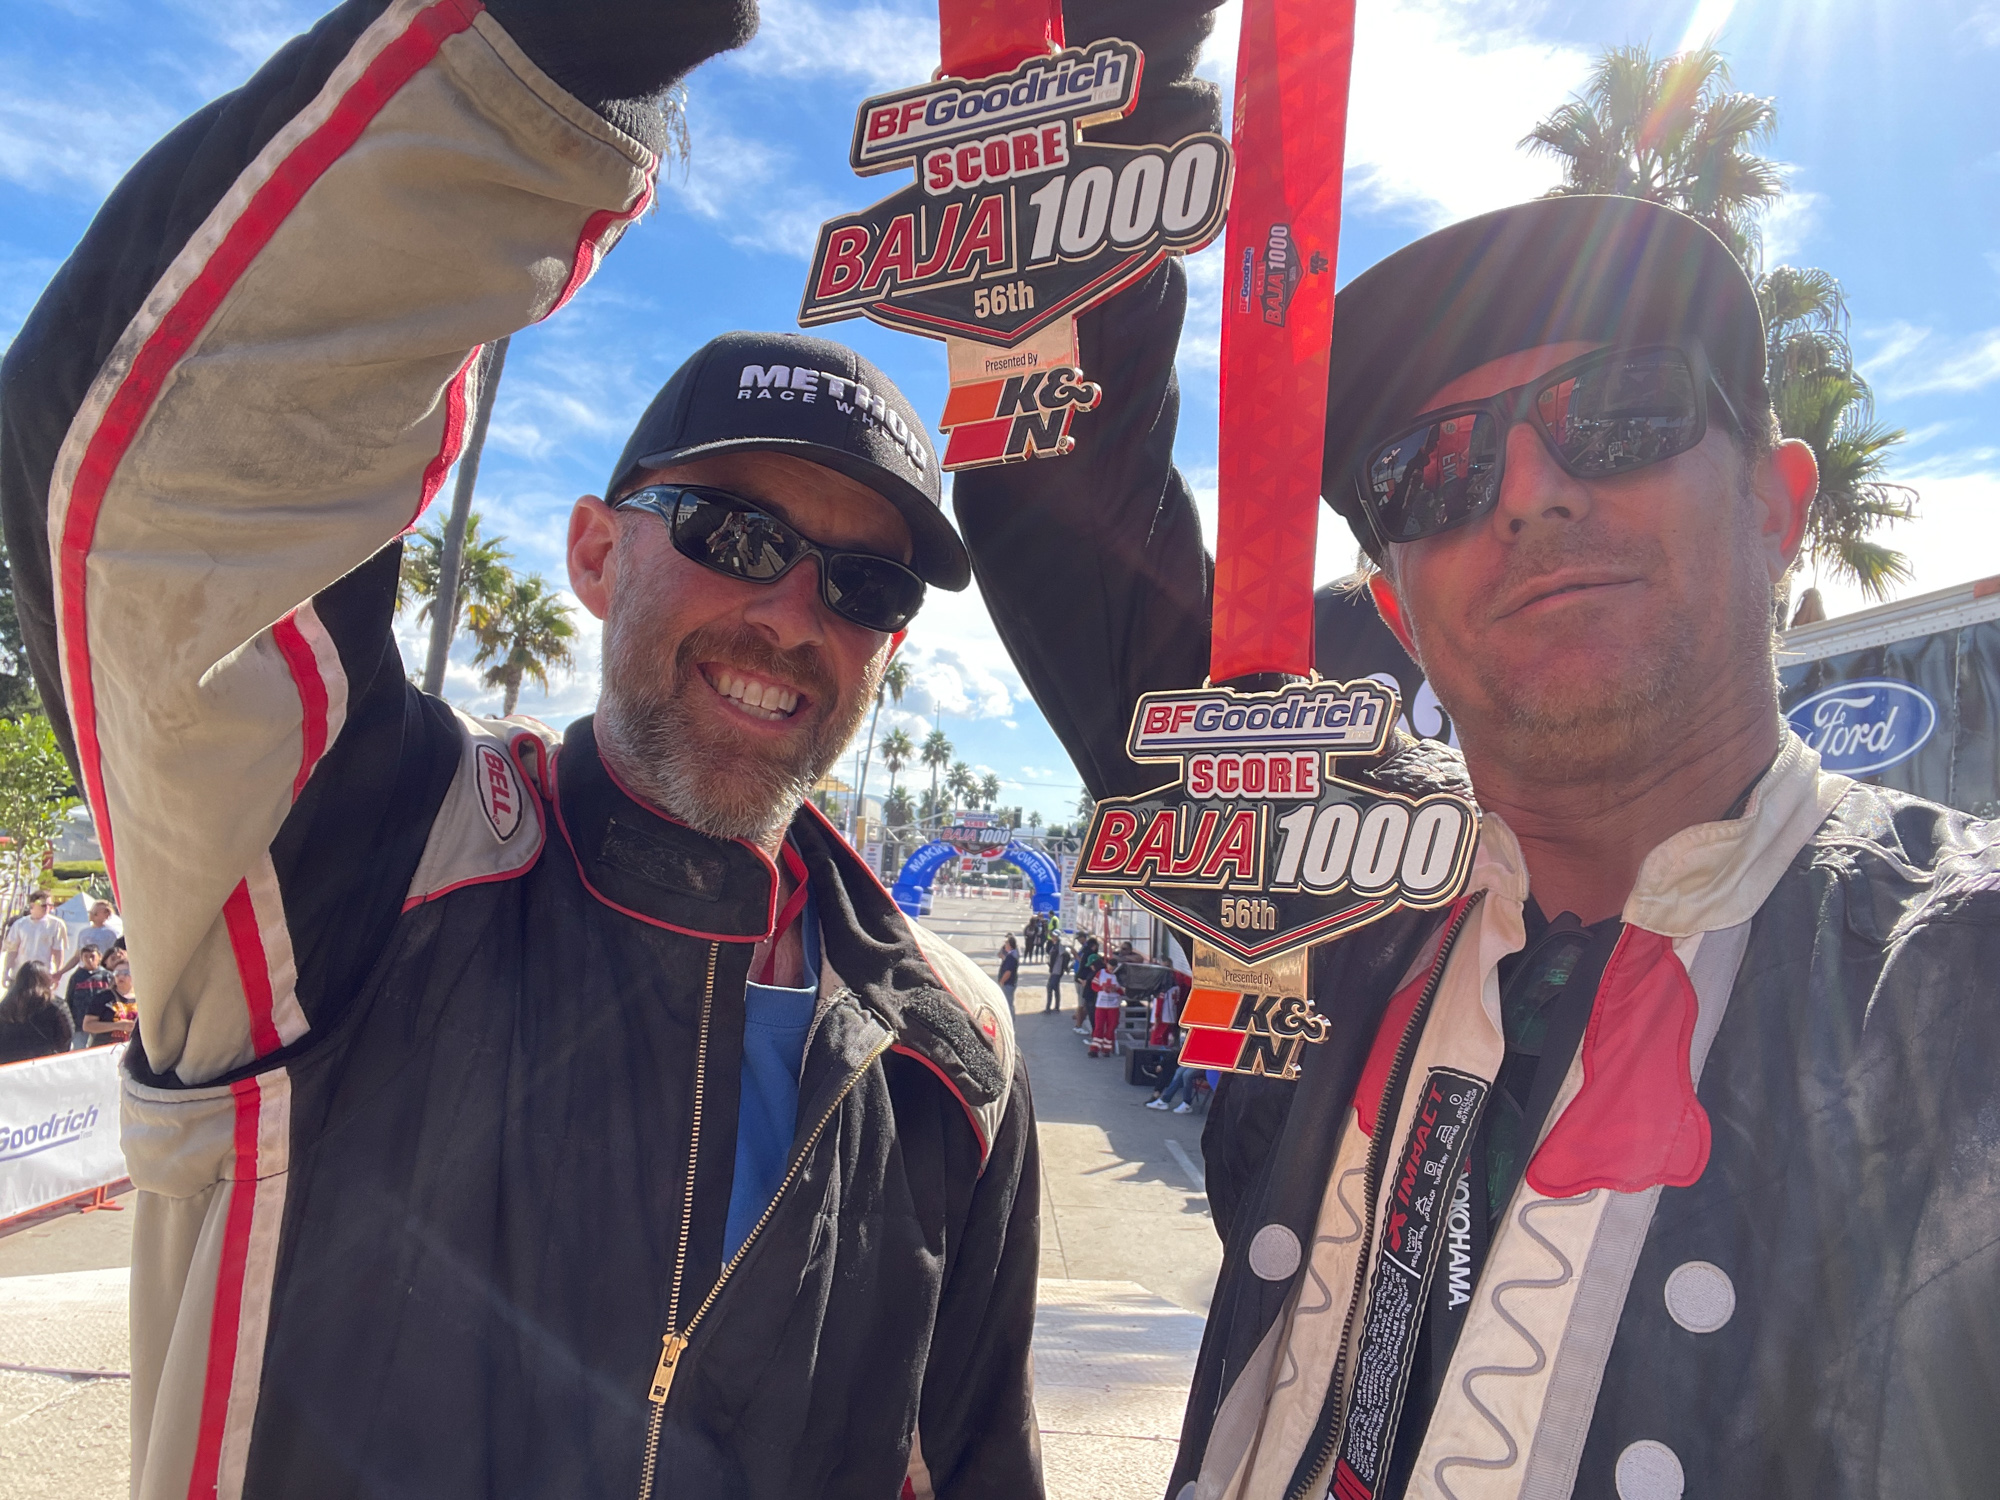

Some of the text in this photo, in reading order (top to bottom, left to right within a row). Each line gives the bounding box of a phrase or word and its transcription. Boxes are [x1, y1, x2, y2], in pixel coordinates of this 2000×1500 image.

[867, 53, 1119, 141] BFGoodrich
[928, 126, 1065, 190] SCORE
[815, 142, 1218, 299] BAJA 1000
[974, 281, 1034, 319] 56th
[1265, 225, 1288, 323] BAJA 1000
[985, 352, 1038, 371] Presented By
[737, 389, 818, 403] RACE
[739, 364, 927, 471] METHOD
[1143, 697, 1378, 734] BFGoodrich
[1805, 694, 1899, 757] Ford
[483, 751, 511, 815] BELL
[1192, 757, 1314, 793] SCORE
[942, 828, 1011, 844] BAJA 1000
[1086, 804, 1462, 889] BAJA 1000
[1221, 899, 1277, 930] 56th
[1225, 970, 1274, 986] Presented By
[1397, 1081, 1443, 1207] IMPACT
